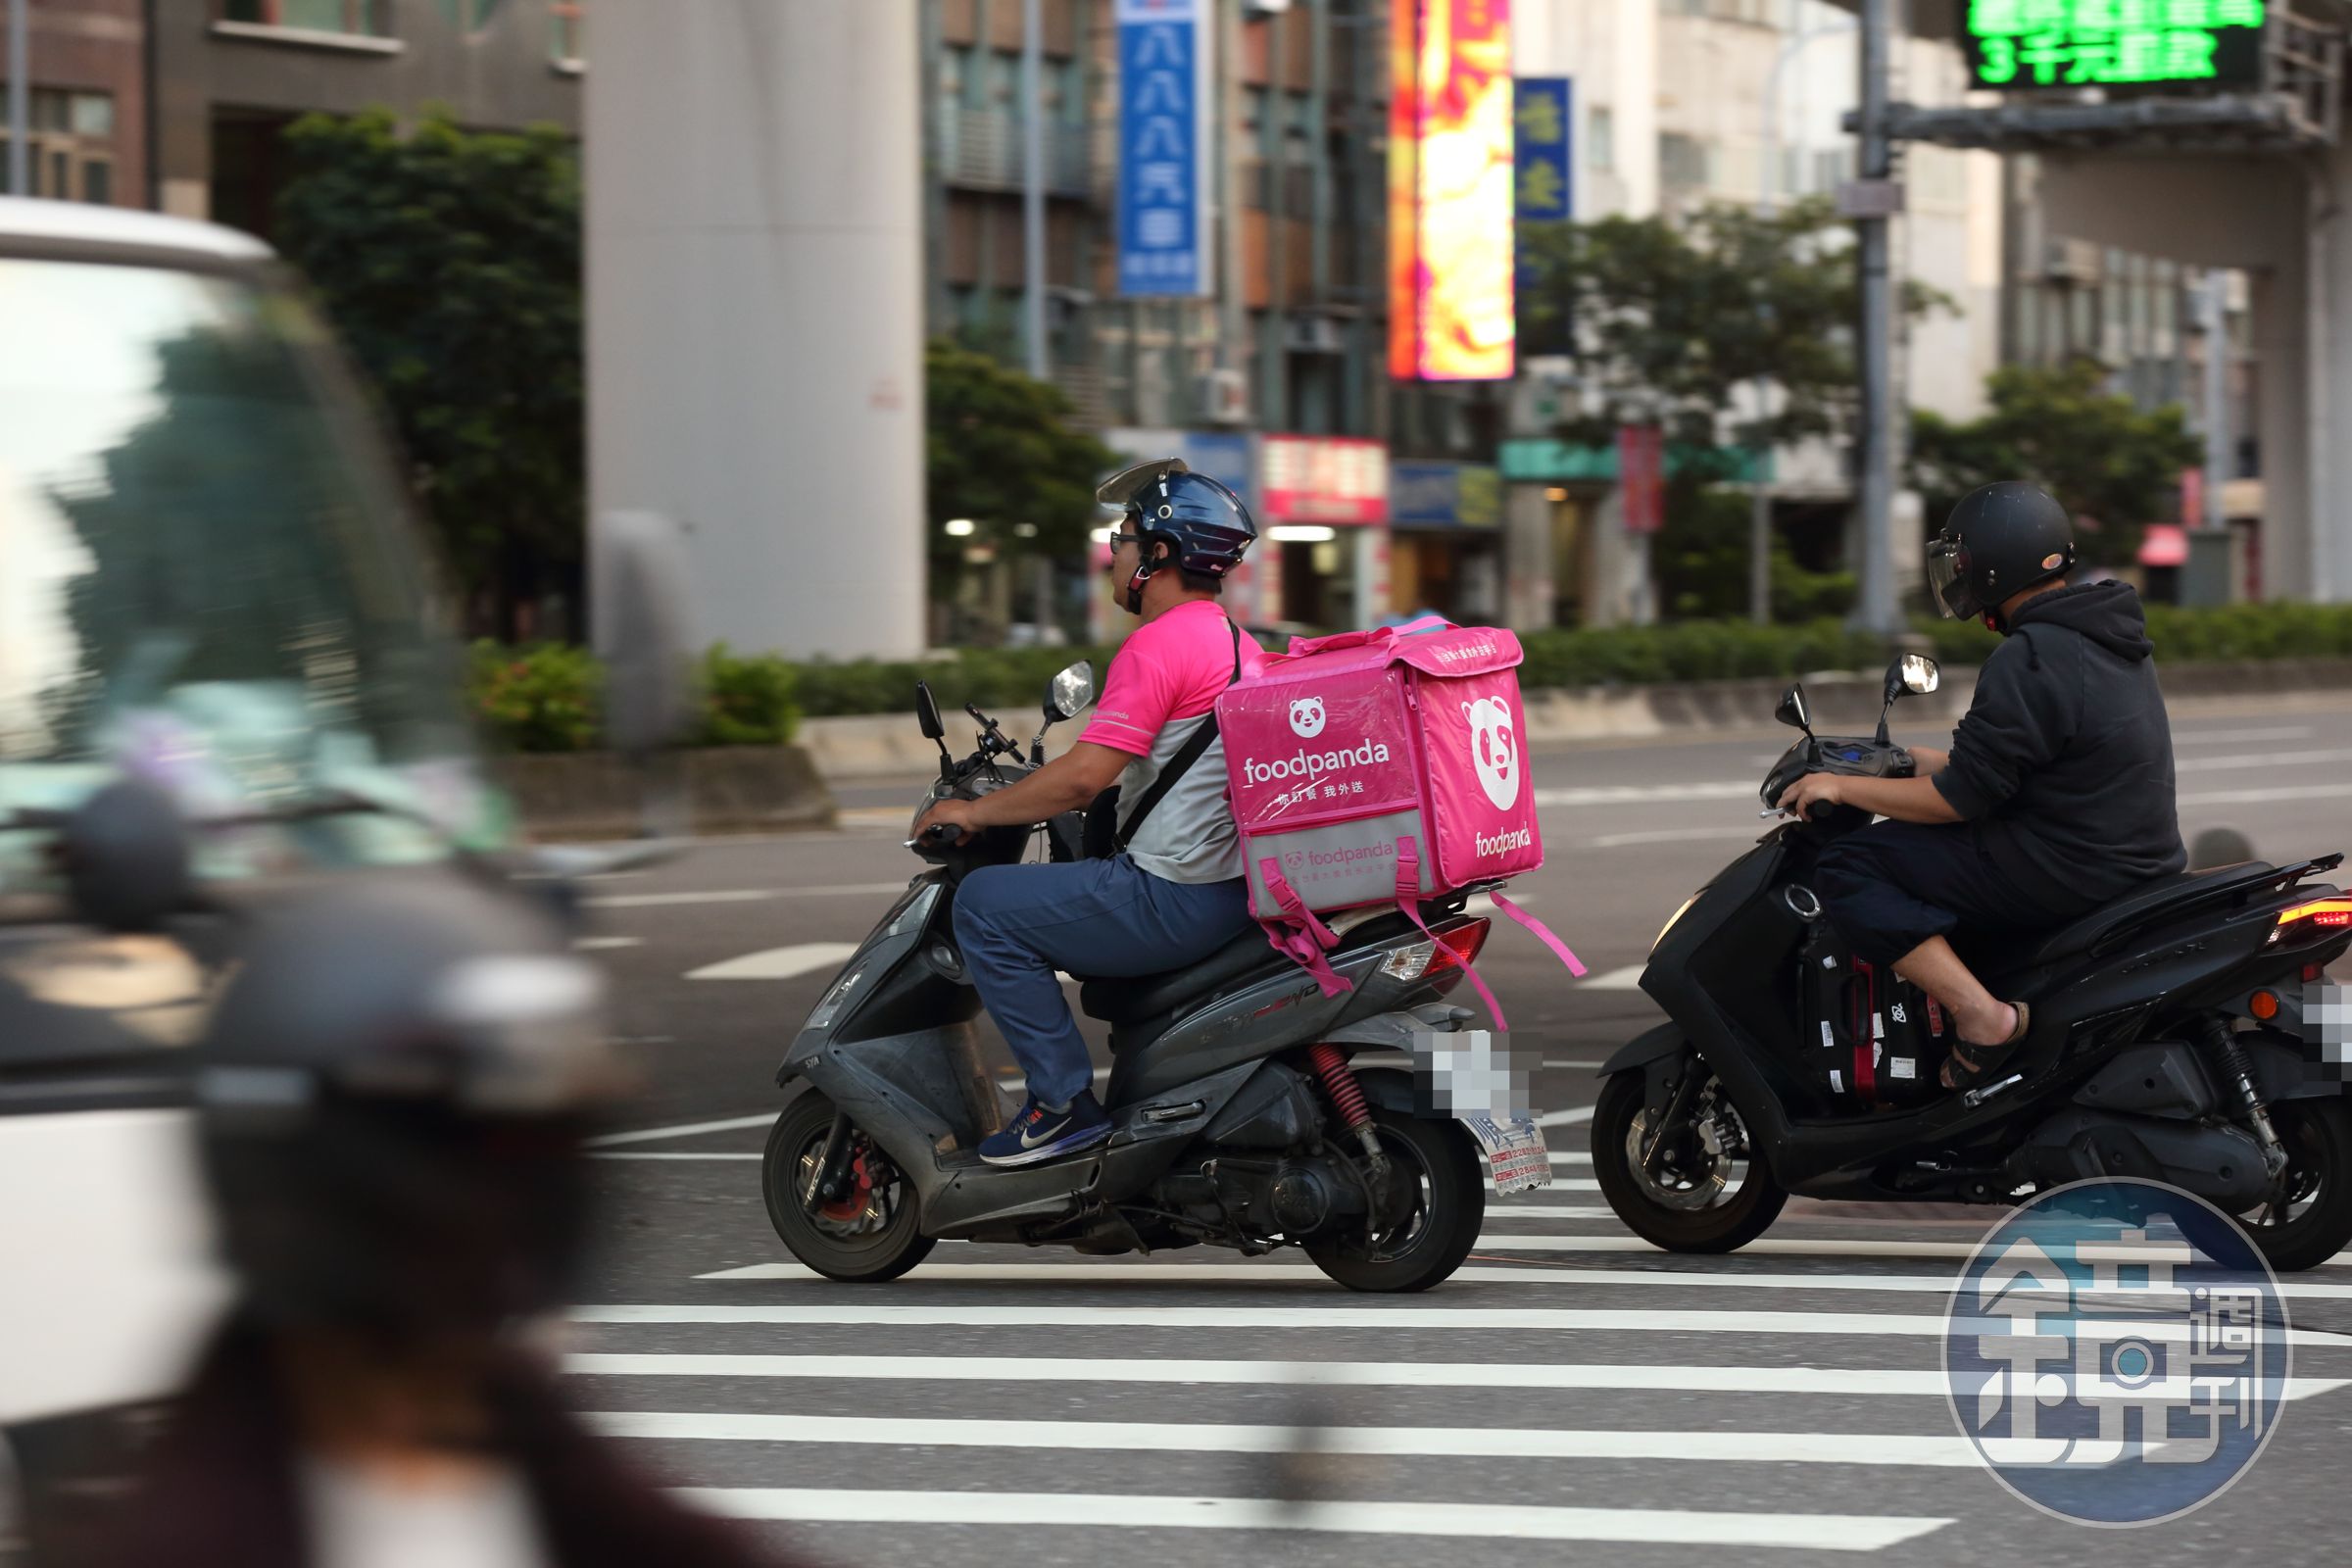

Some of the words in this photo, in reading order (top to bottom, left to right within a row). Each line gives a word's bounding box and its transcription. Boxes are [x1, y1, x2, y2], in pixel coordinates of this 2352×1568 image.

[1245, 739, 1390, 782] foodpanda
[1278, 787, 1317, 806] 你訂餐
[1324, 780, 1364, 799] 我外送
[1308, 840, 1394, 865] foodpanda
[1476, 821, 1531, 859] foodpanda
